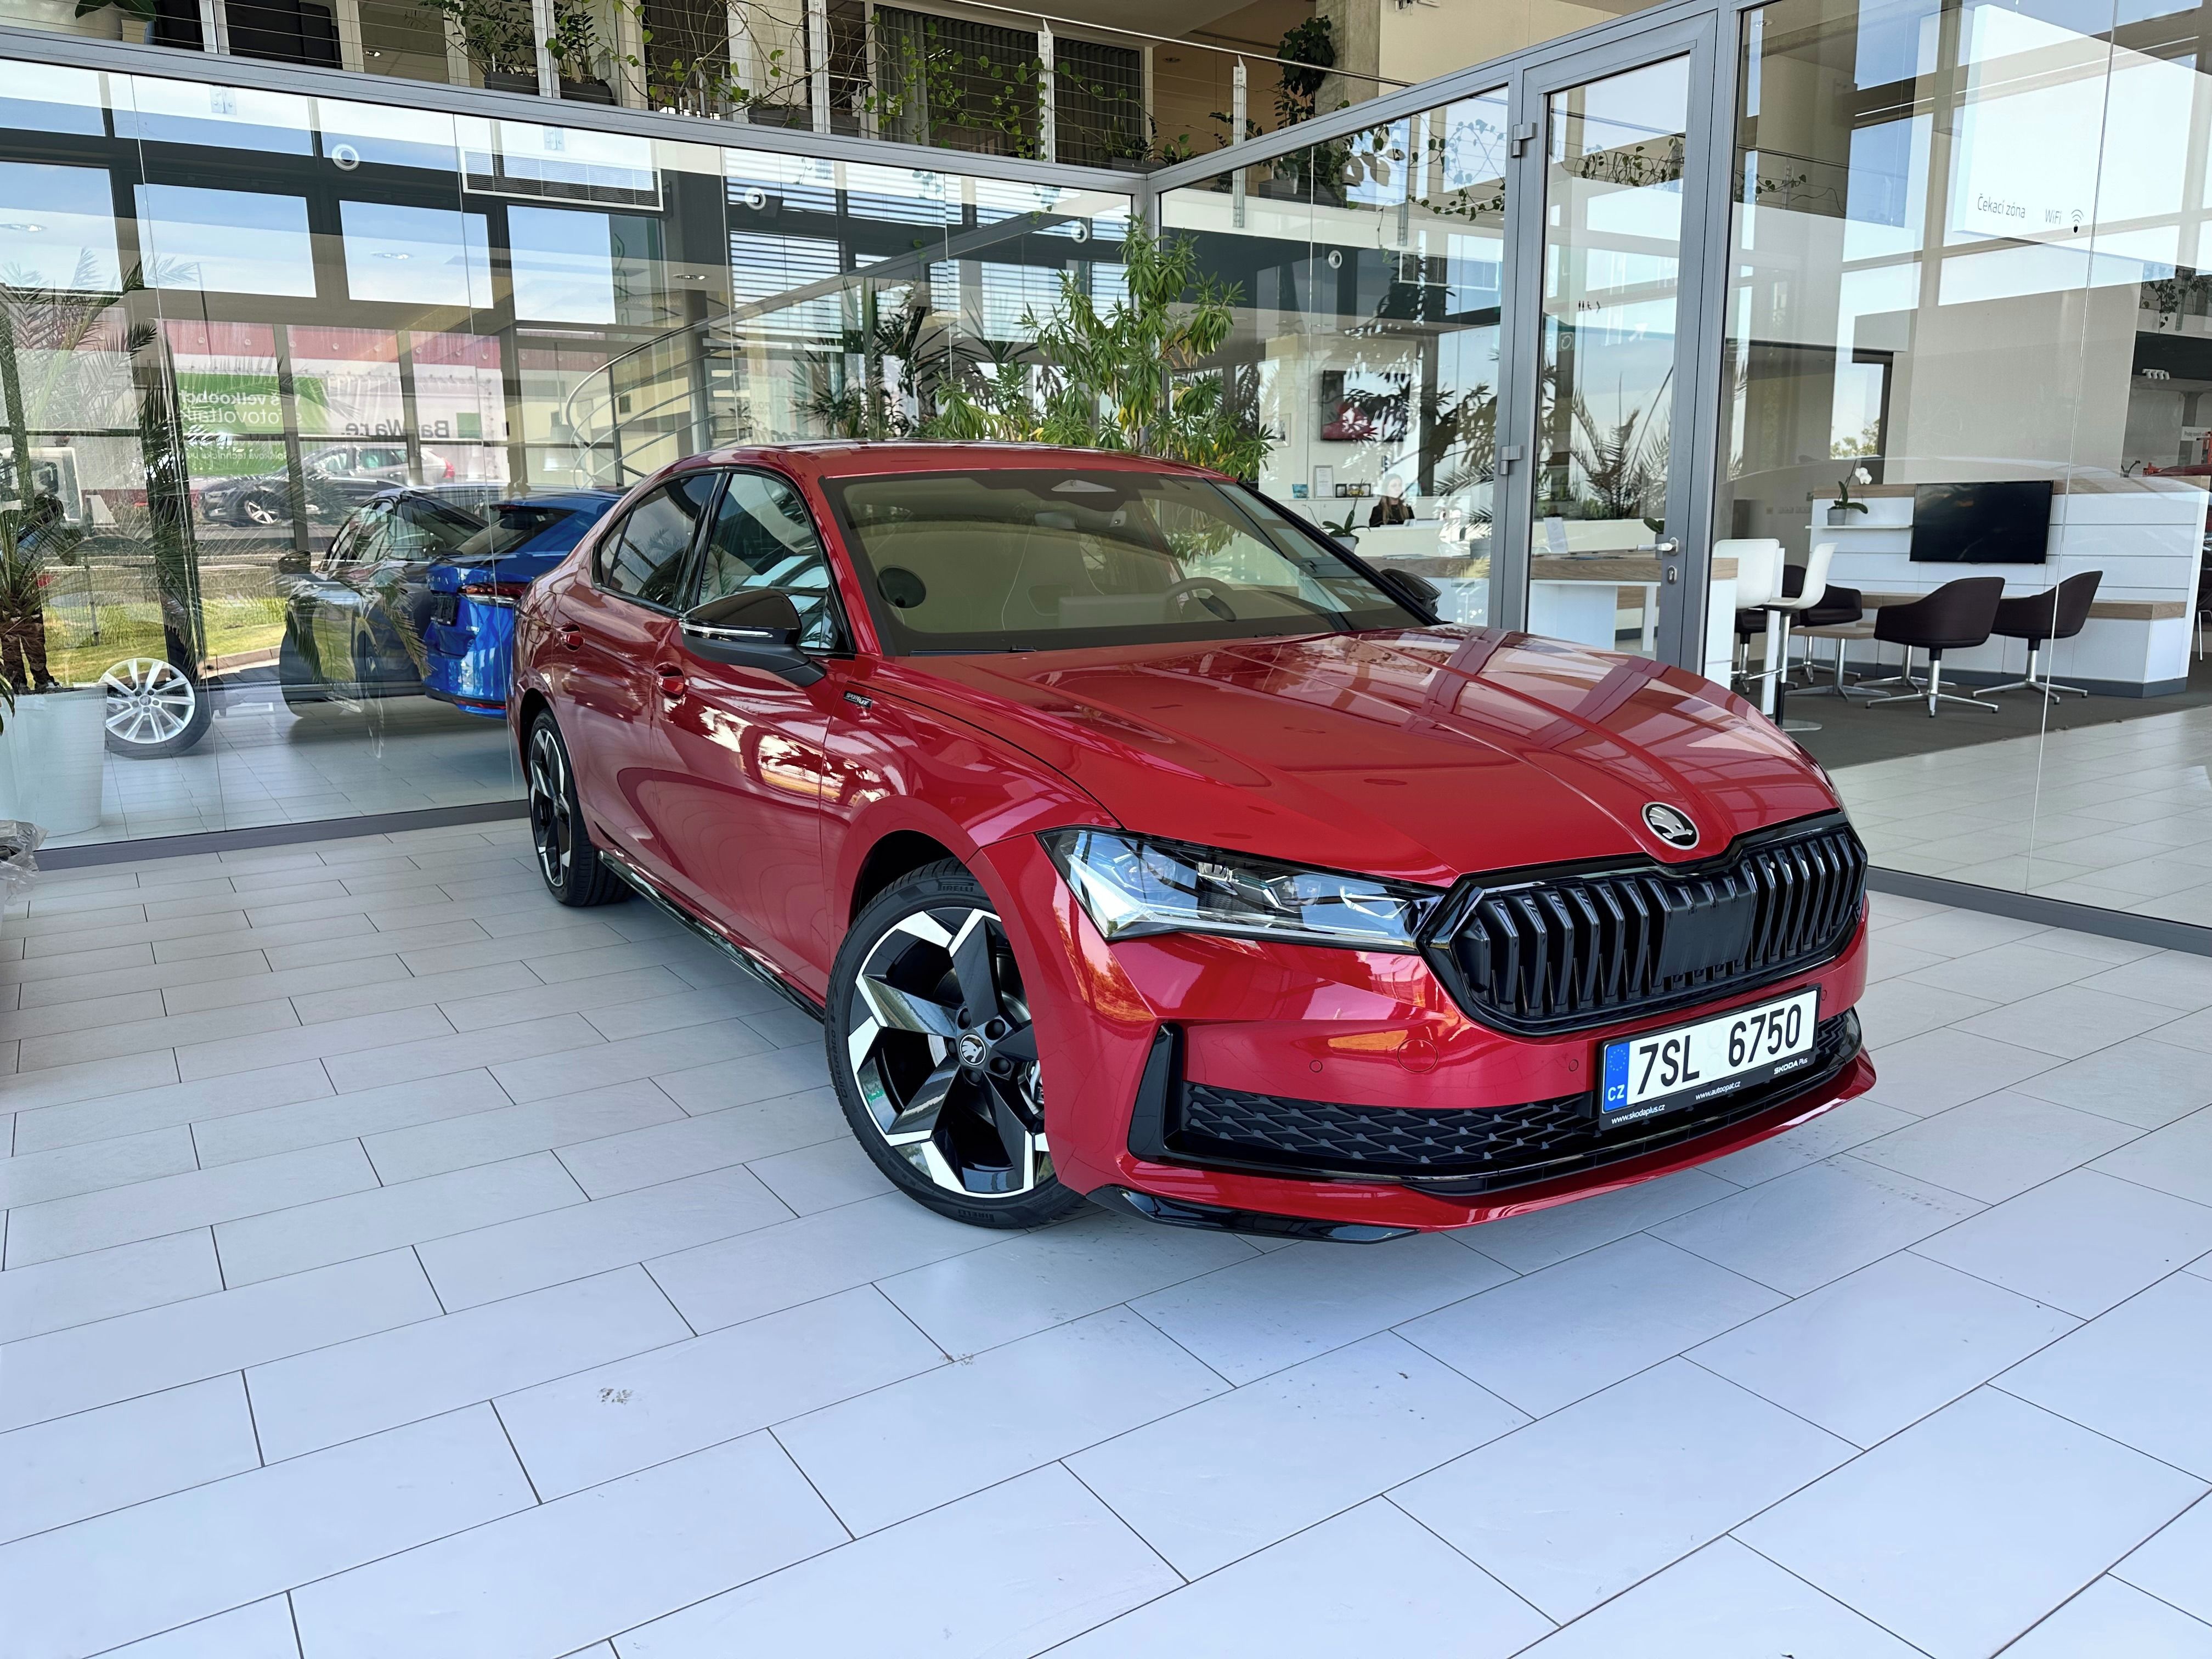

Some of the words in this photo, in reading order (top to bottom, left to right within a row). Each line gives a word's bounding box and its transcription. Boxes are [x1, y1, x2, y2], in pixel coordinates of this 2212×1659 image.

[1977, 193, 2005, 215] Čekací
[2006, 201, 2025, 218] zóna
[2045, 208, 2062, 224] WiFi
[938, 881, 974, 892] PIRELLI
[1637, 1034, 1700, 1096] 7SL
[1728, 1003, 1802, 1067] 6750
[831, 1030, 848, 1099] Cinturato
[1607, 1084, 1626, 1102] CZ
[1695, 1080, 1741, 1101] www.autoopat.cz
[1611, 1103, 1666, 1124] www.skodaplus.cz
[957, 1209, 995, 1223] PIRELLI
